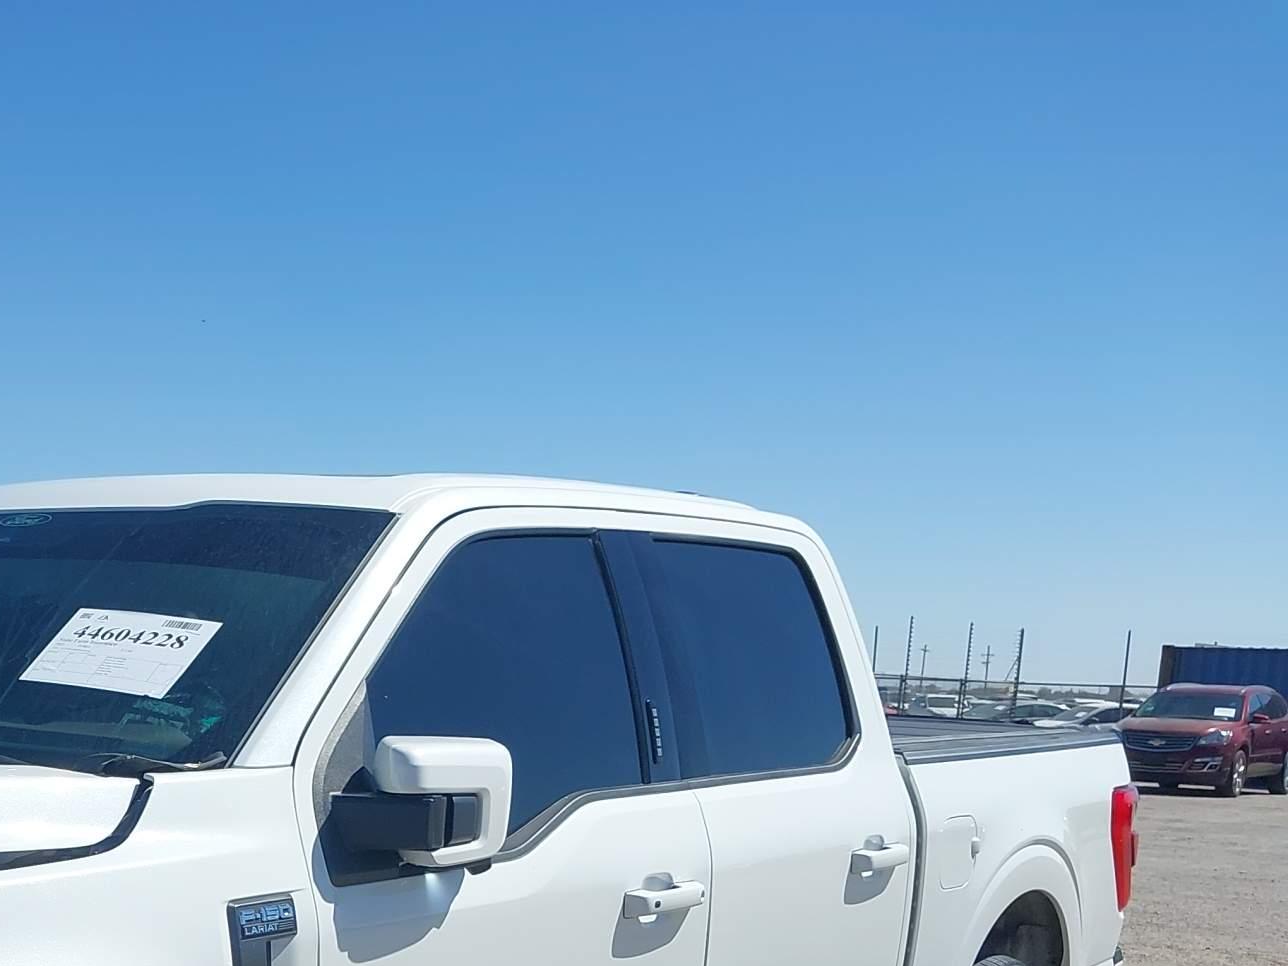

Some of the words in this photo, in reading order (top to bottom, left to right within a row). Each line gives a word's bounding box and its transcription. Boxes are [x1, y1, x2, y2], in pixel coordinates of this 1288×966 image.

[73, 625, 189, 649] 44604228
[239, 903, 294, 925] F-150
[245, 922, 280, 935] LARIAT
